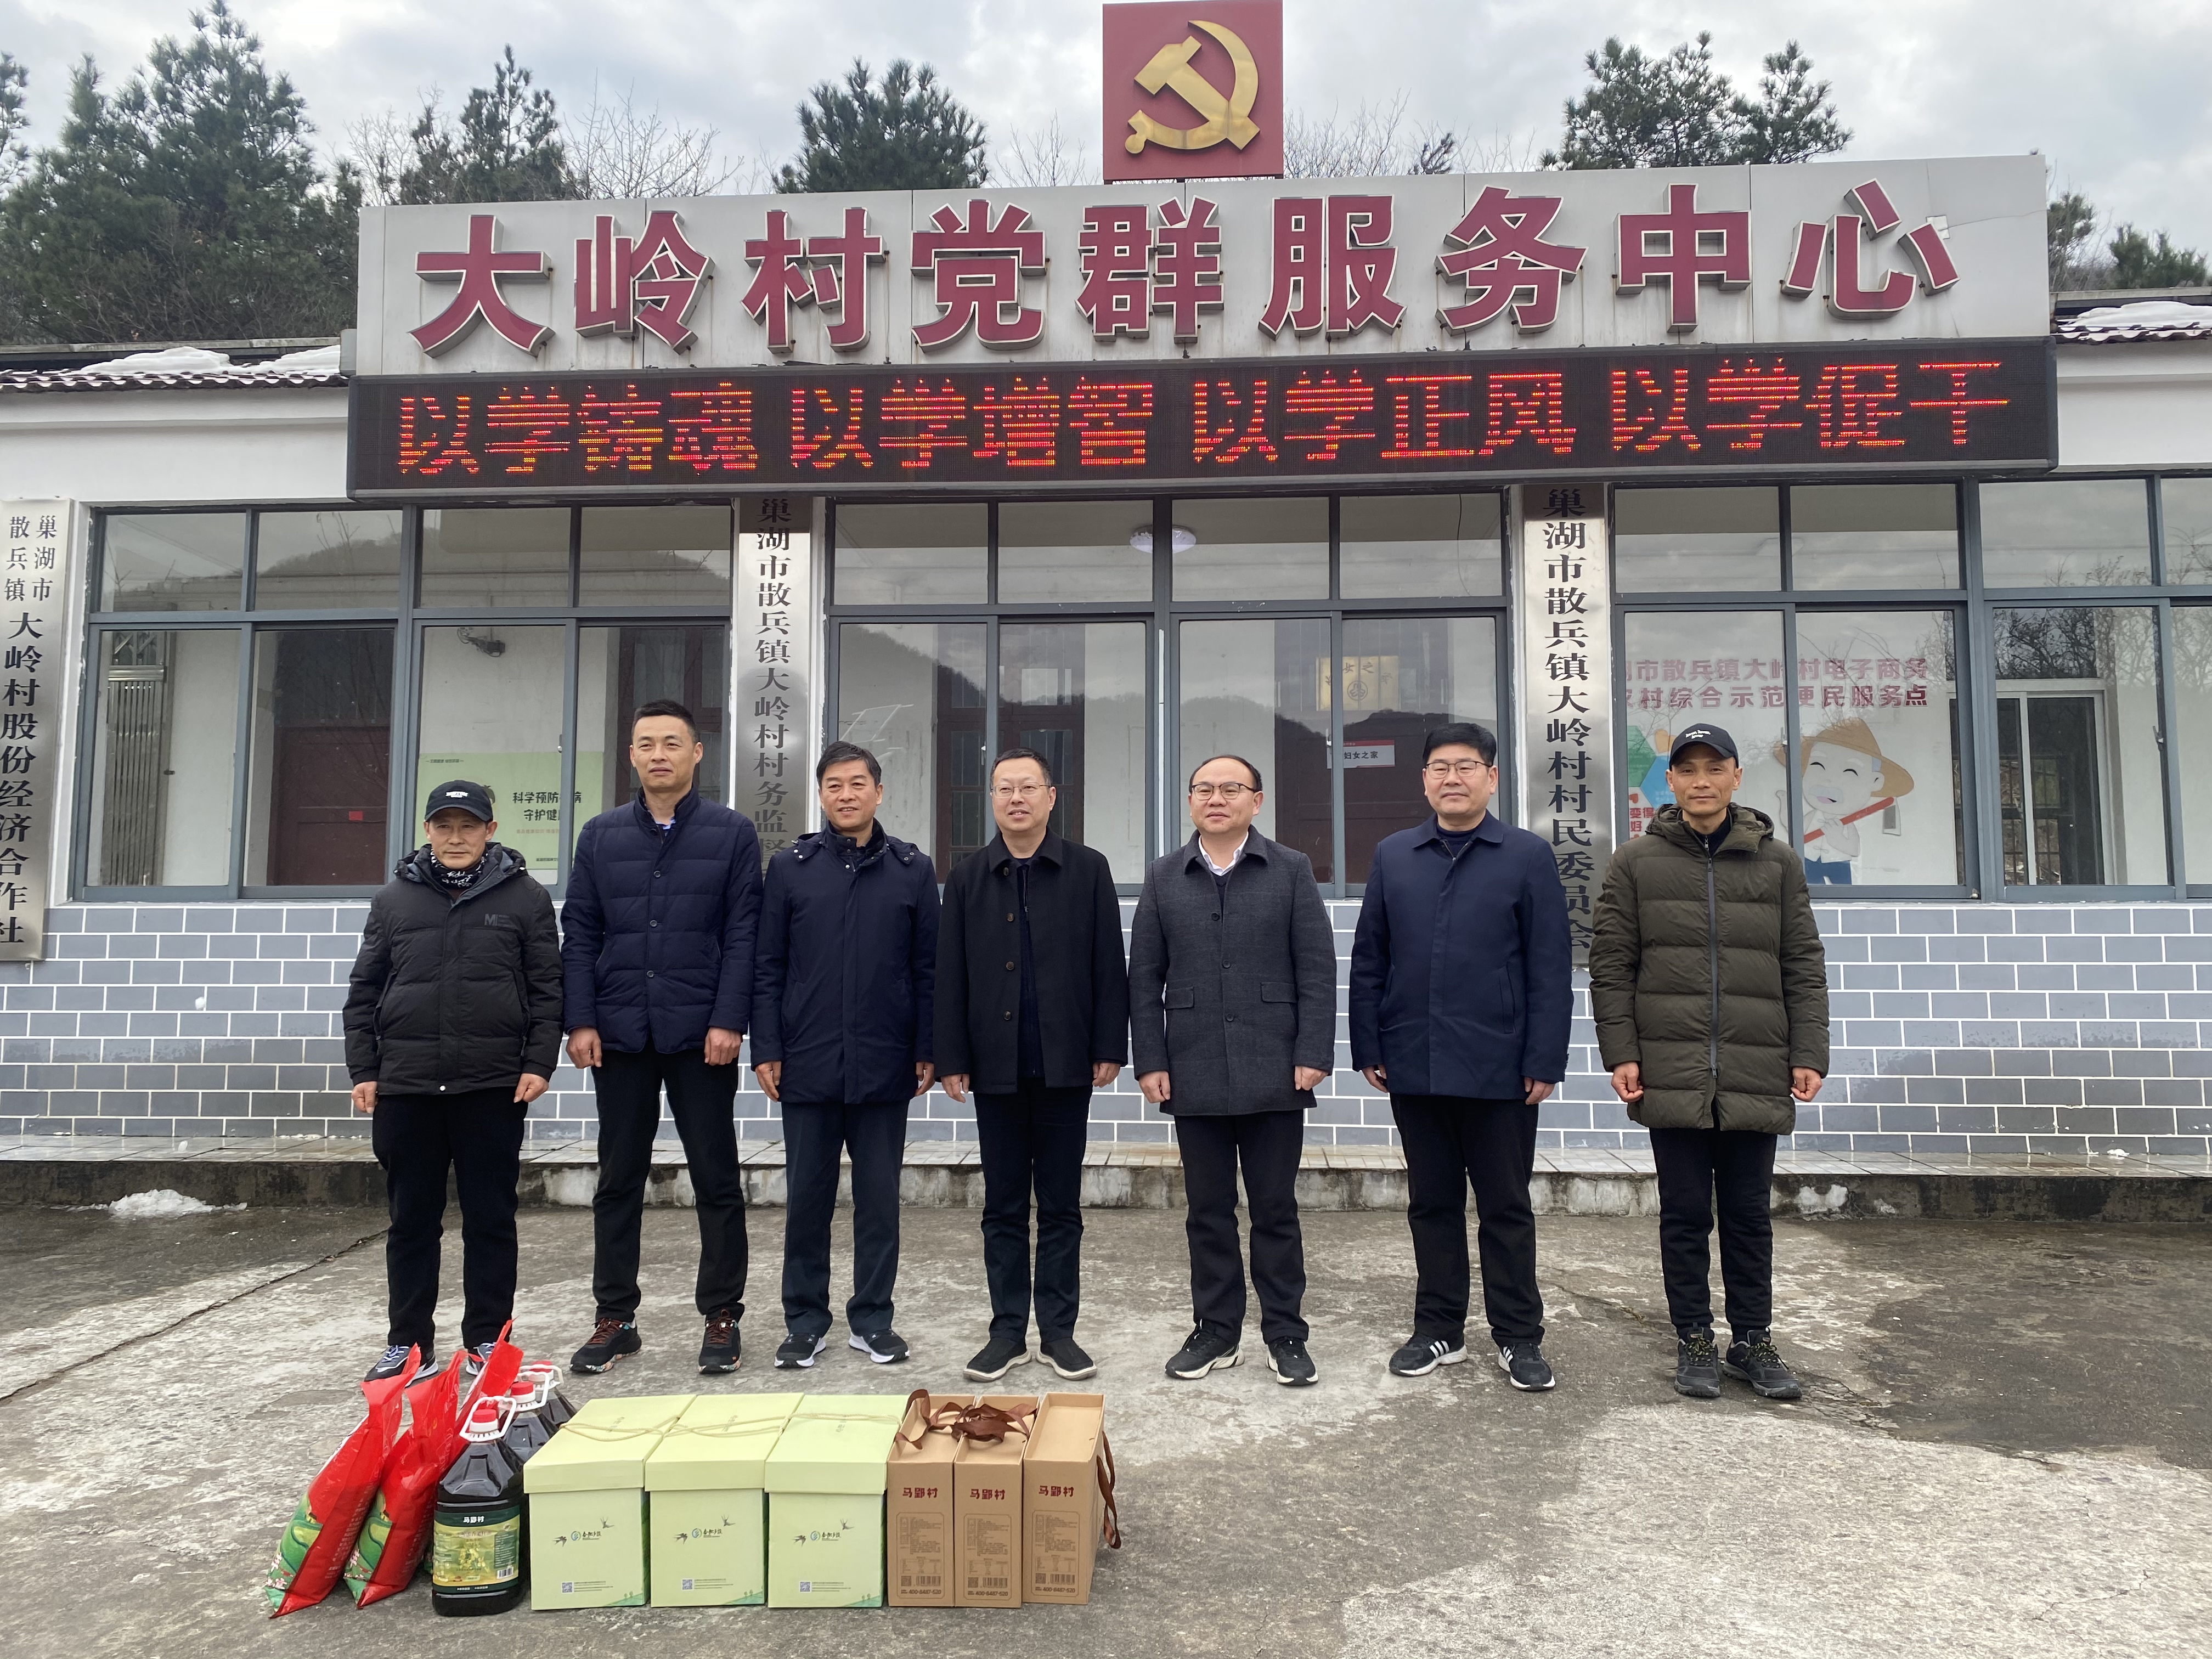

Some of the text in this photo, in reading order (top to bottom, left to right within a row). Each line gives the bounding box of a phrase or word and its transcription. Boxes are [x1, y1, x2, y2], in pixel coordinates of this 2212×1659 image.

[410, 178, 1961, 357] 大岭村党群服务中心
[398, 357, 2009, 475] 以学铸魂 以学增智 以学正风 以学促干
[4, 516, 30, 602] 散兵镇
[32, 515, 57, 601] 巢湖市
[753, 498, 791, 877] 巢湖市散兵镇大岭村村务监督
[1626, 658, 1927, 681] 市散兵镇大村电子商务
[0, 612, 43, 943] 大岭村股份经济合作社
[512, 792, 582, 803] 科学预防病
[1344, 751, 1378, 759] 妇女之家
[523, 809, 560, 821] 守护健
